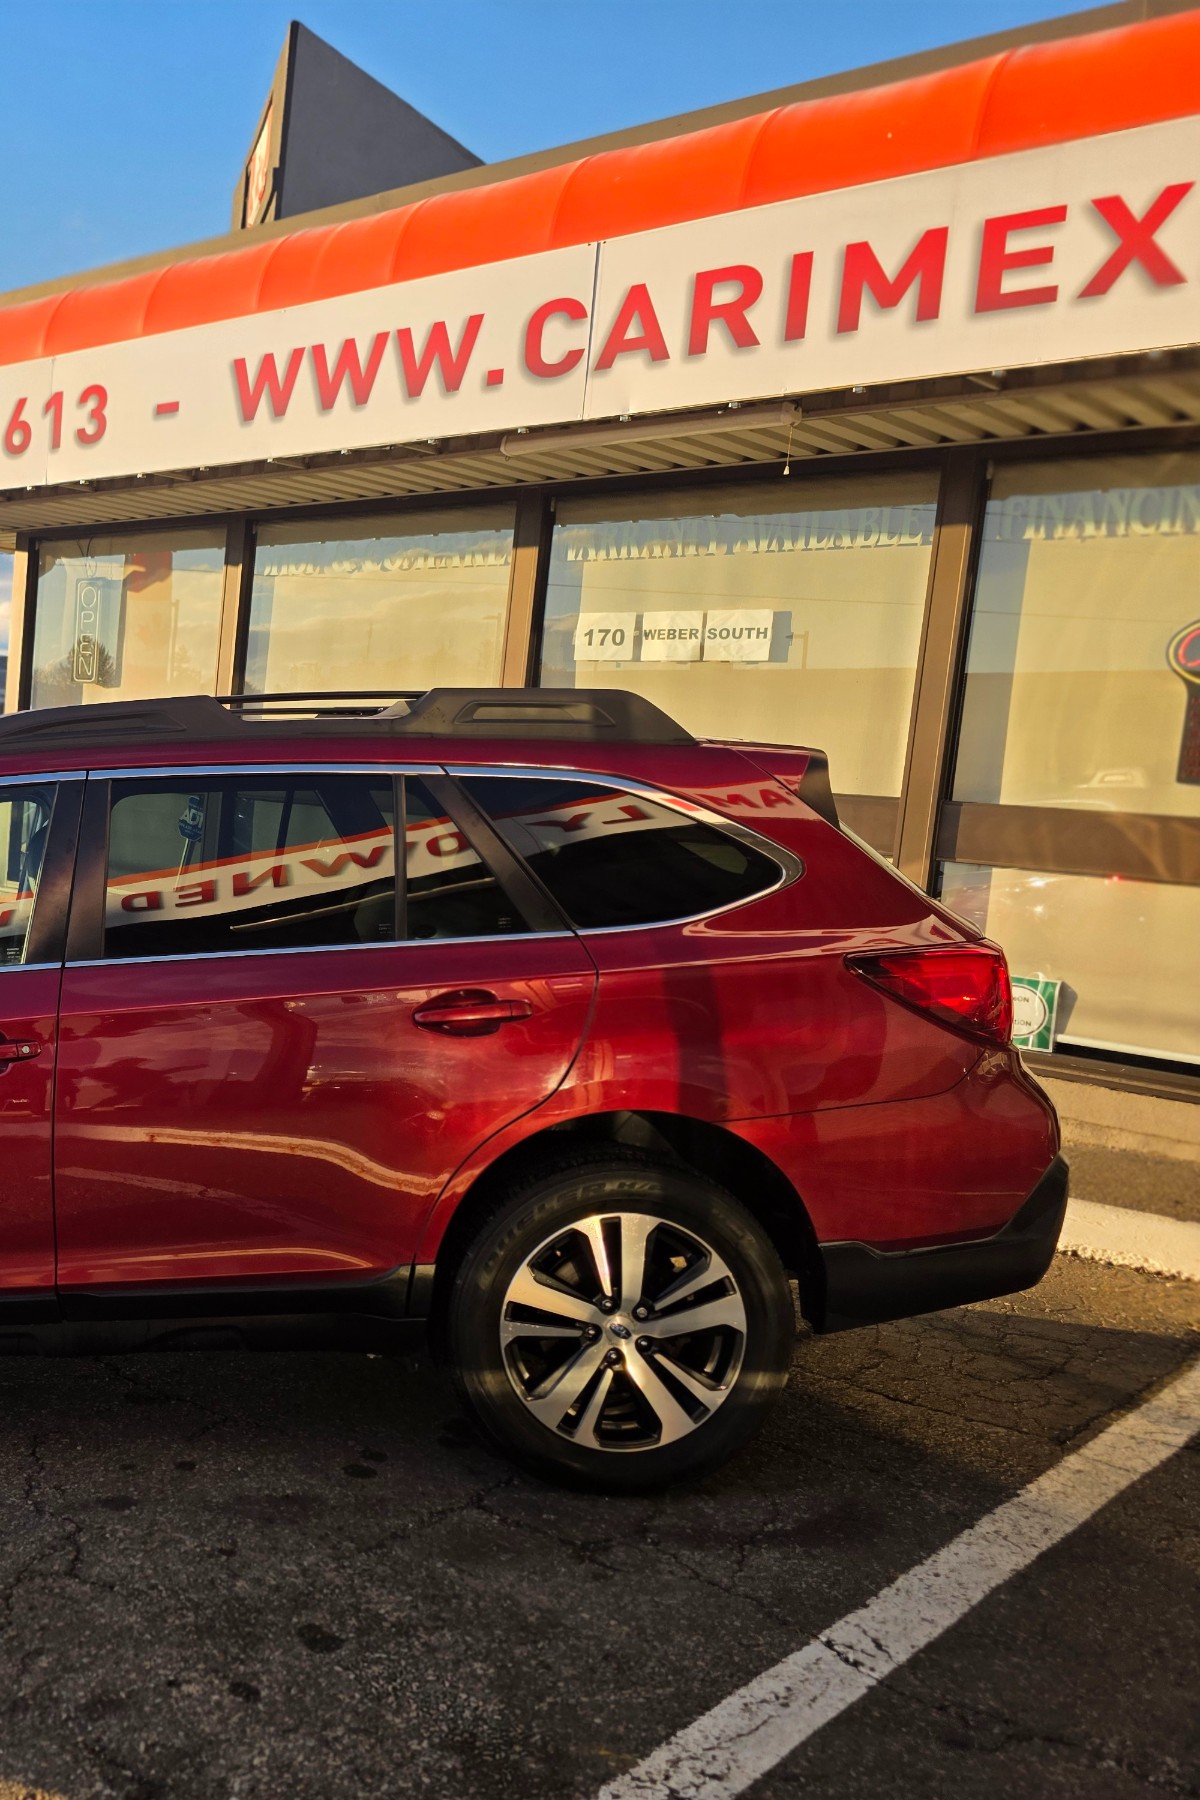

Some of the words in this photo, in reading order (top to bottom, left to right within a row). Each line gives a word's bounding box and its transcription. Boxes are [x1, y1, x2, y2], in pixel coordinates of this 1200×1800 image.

[233, 181, 1196, 422] WWW.CARIMEX
[78, 586, 97, 676] OPEN
[583, 628, 626, 647] 170
[643, 627, 700, 640] WEBER
[706, 626, 769, 640] SOUTH
